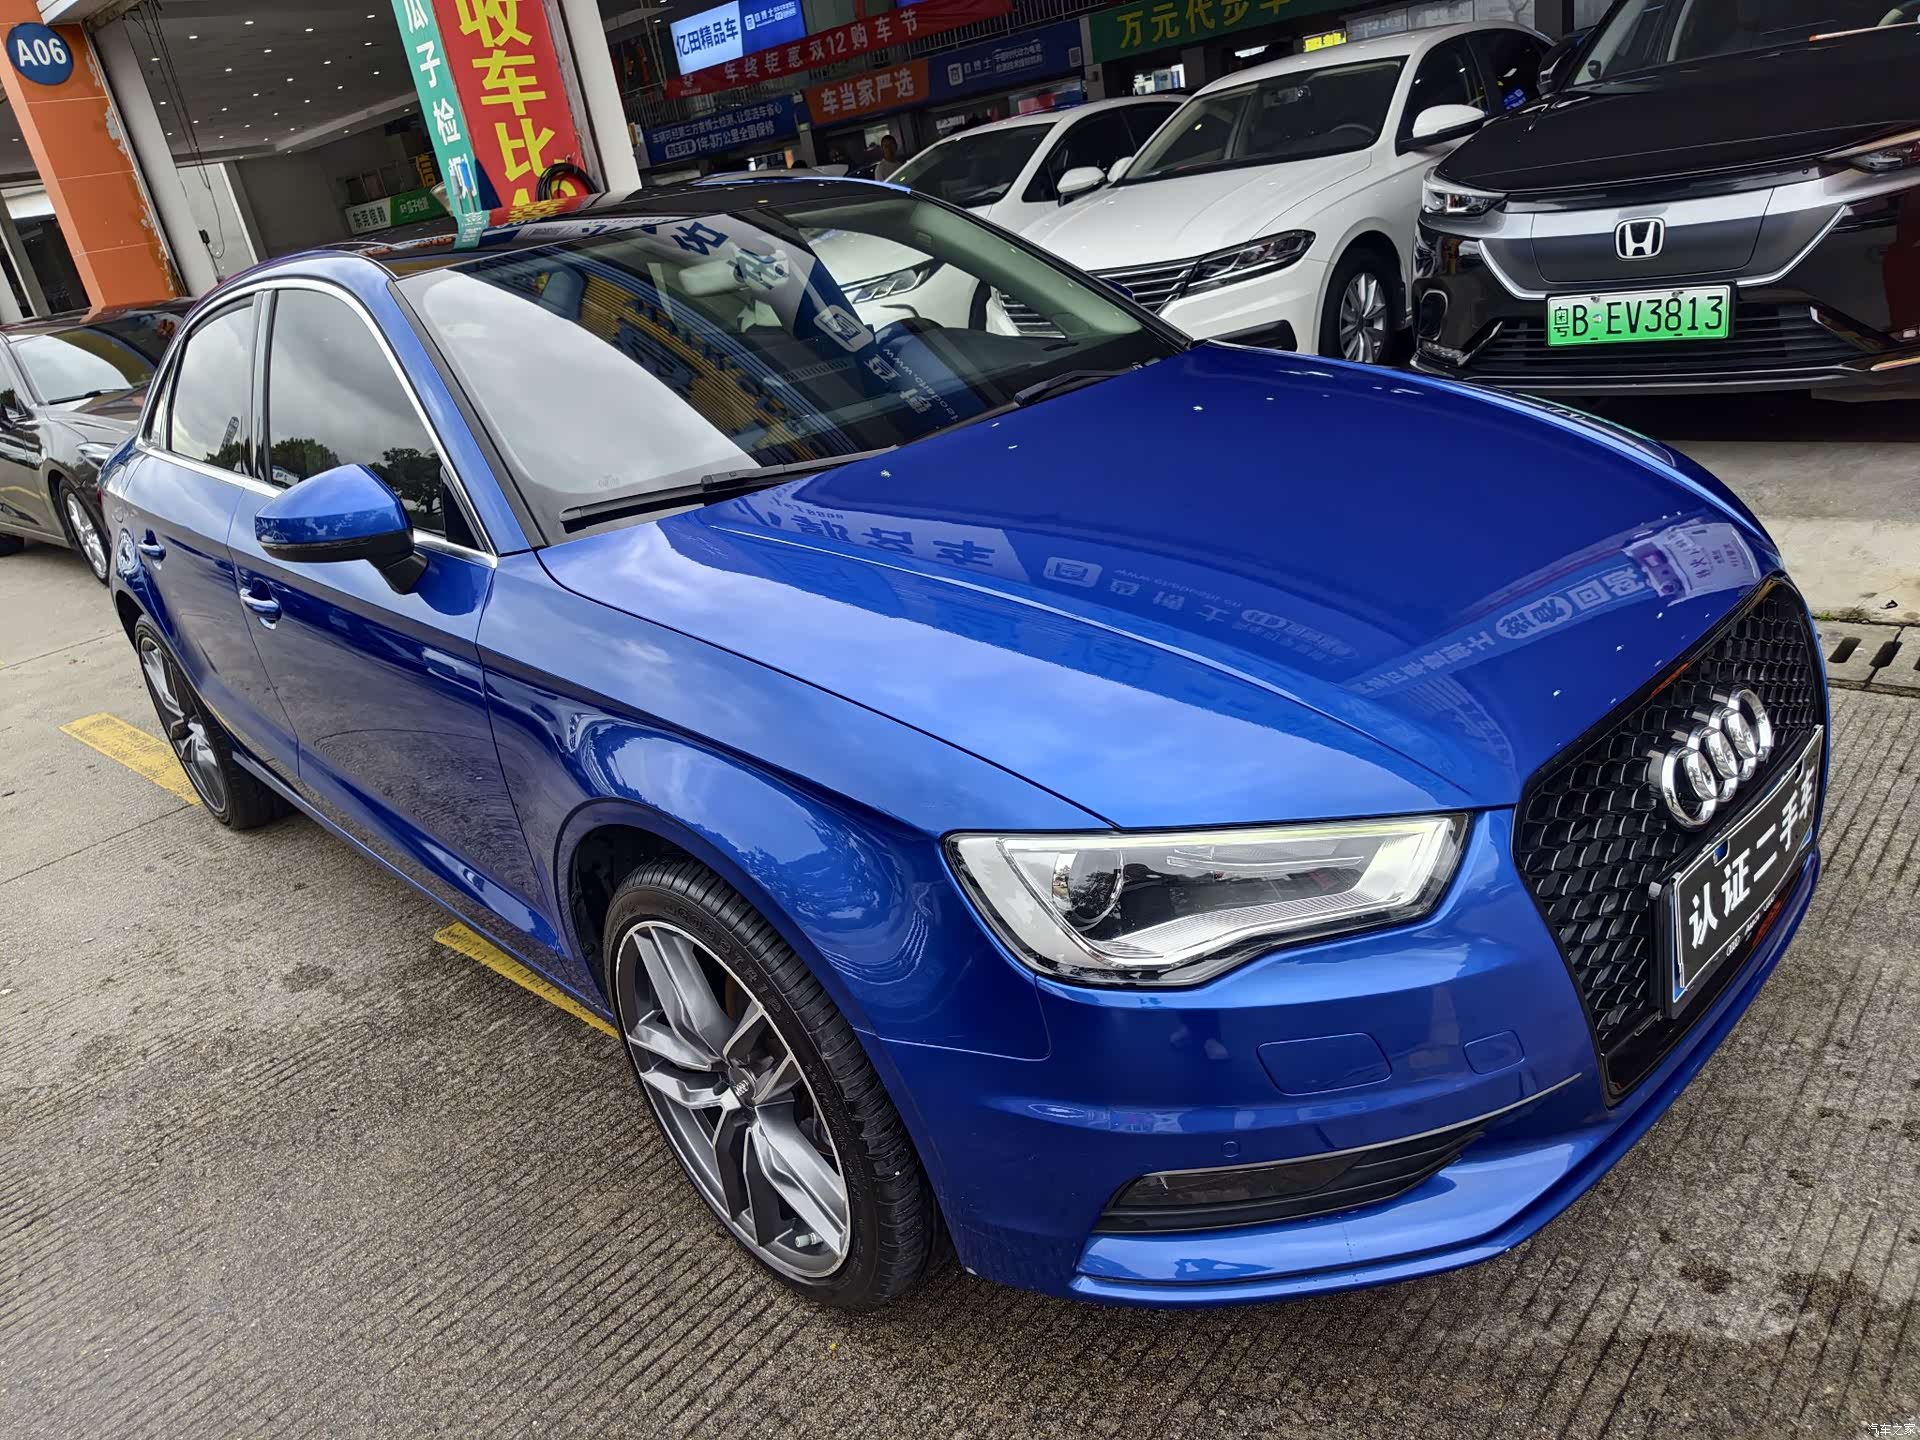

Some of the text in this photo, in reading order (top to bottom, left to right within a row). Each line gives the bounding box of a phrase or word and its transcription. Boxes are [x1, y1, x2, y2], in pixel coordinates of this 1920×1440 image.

[16, 37, 67, 67] A06
[676, 17, 739, 57] 亿田精品车
[821, 67, 915, 115] 车当家严选
[1688, 766, 1816, 949] 认证二手车
